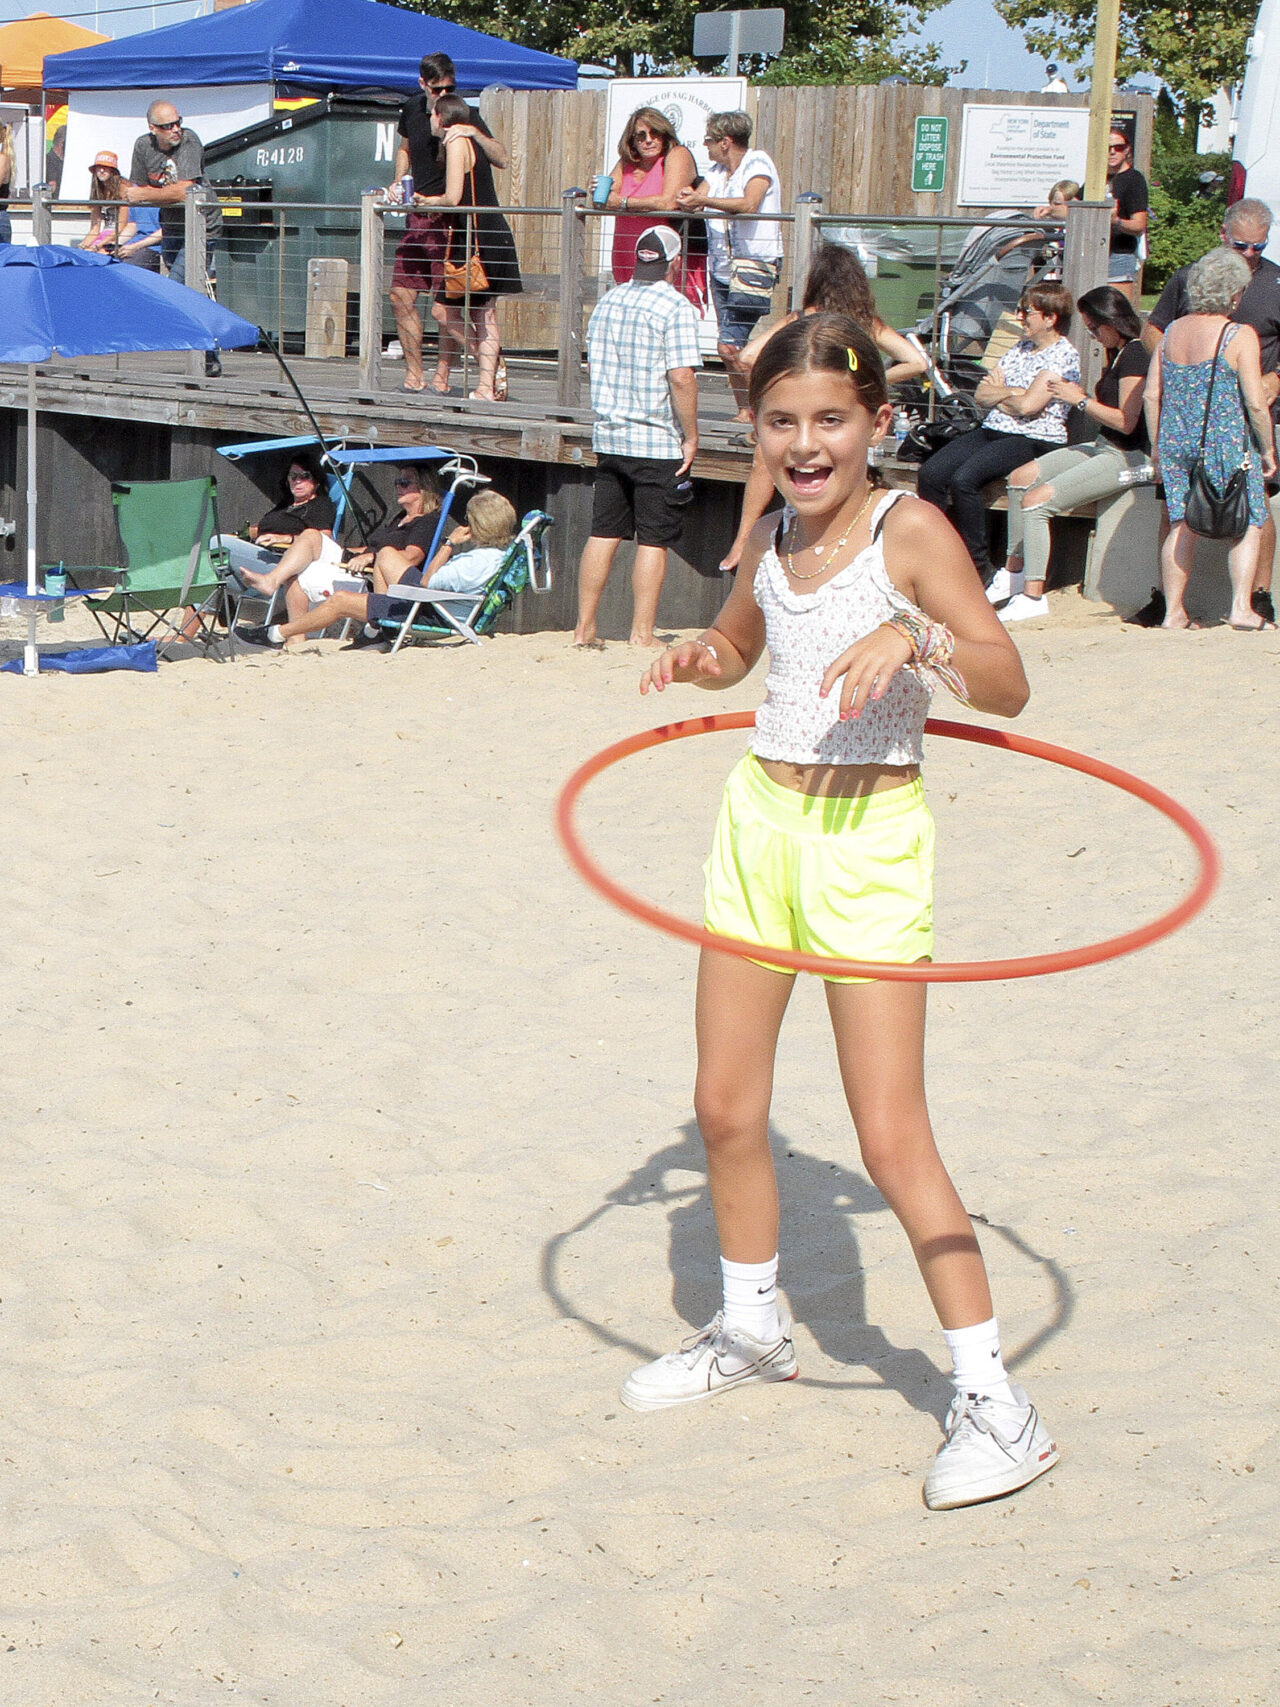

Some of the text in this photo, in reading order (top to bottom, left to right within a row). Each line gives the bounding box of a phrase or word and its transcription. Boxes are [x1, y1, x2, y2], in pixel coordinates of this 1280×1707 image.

[661, 91, 672, 100] OF
[672, 91, 688, 100] SAG
[688, 94, 714, 114] HARBO
[921, 124, 942, 132] DO NOT
[1033, 119, 1070, 129] Department
[922, 133, 941, 142] LITTER
[1033, 130, 1057, 139] of State
[918, 143, 942, 151] DISPOSE
[916, 152, 944, 161] OF TRASH
[922, 162, 937, 171] HERE
